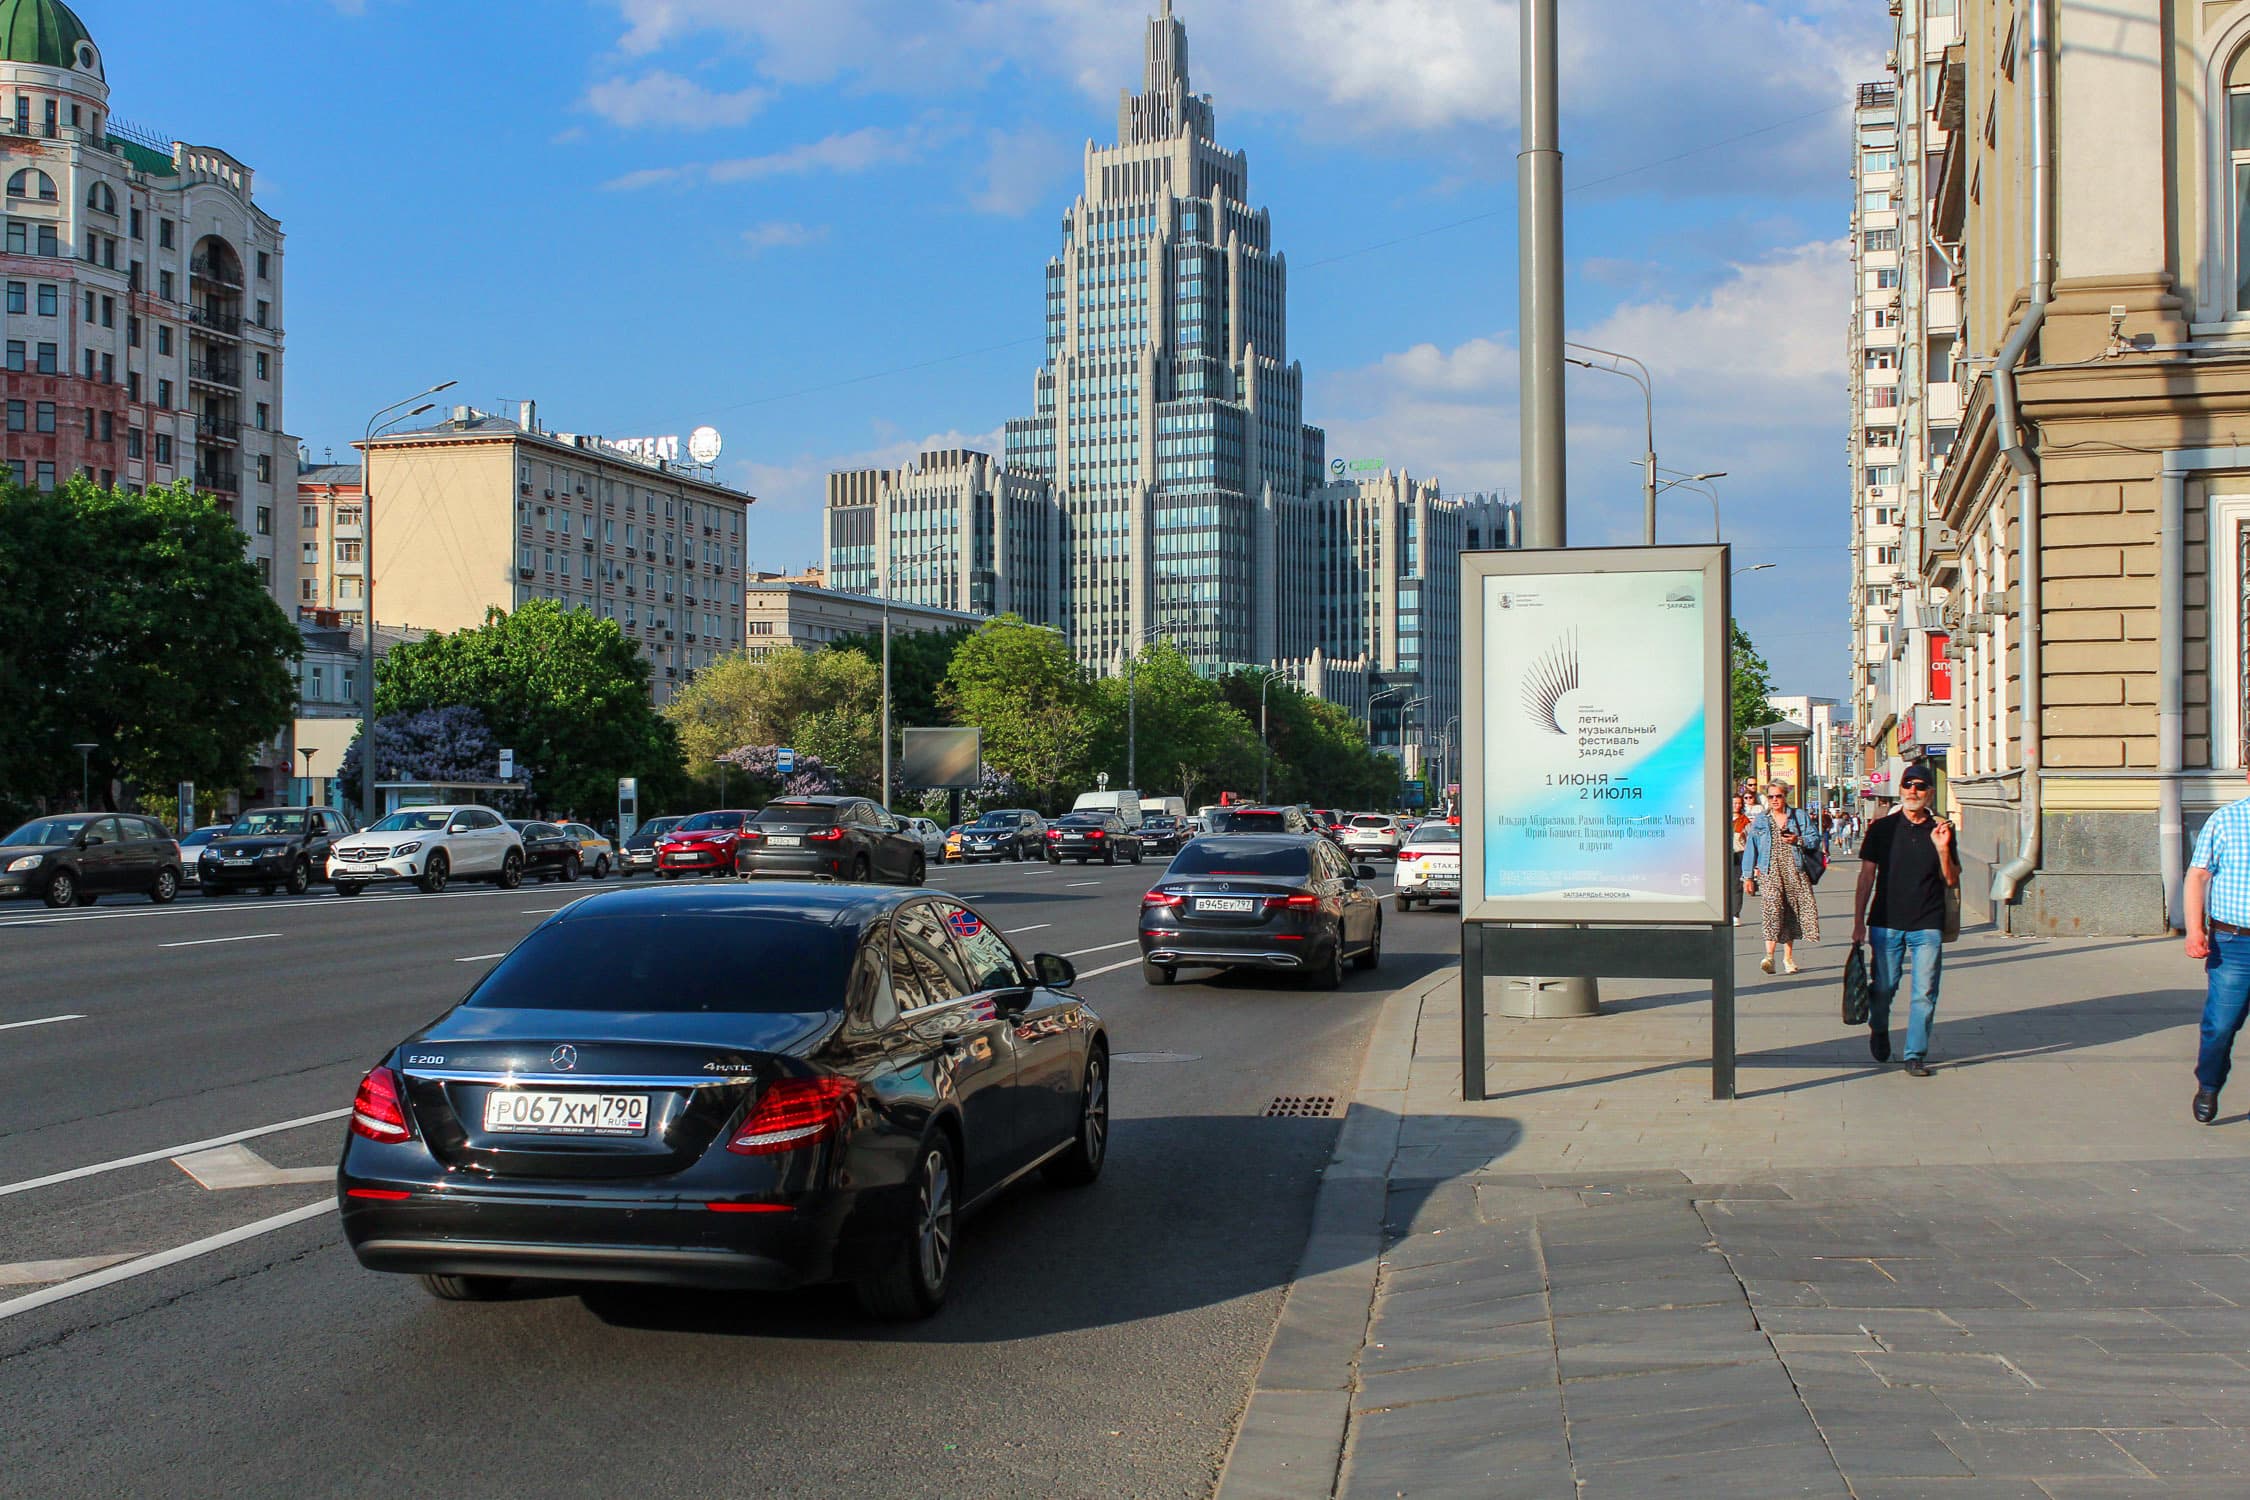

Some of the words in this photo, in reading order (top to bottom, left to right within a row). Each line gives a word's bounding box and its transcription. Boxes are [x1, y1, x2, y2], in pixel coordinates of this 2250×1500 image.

[1578, 714, 1619, 724] летний
[1578, 724, 1657, 736] музыкальный
[1578, 736, 1640, 748] фестиваль
[1578, 748, 1625, 759] ЗАРЯДЬЕ
[1545, 774, 1553, 786] 1
[1558, 773, 1608, 786] ИЮНЯ
[1579, 787, 1588, 800] 2
[1593, 787, 1642, 800] ИЮЛЯ
[1680, 873, 1699, 887] 6+
[409, 1055, 419, 1064] E
[418, 1055, 446, 1065] 200
[602, 1097, 642, 1118] 790
[607, 1118, 628, 1127] RUS
